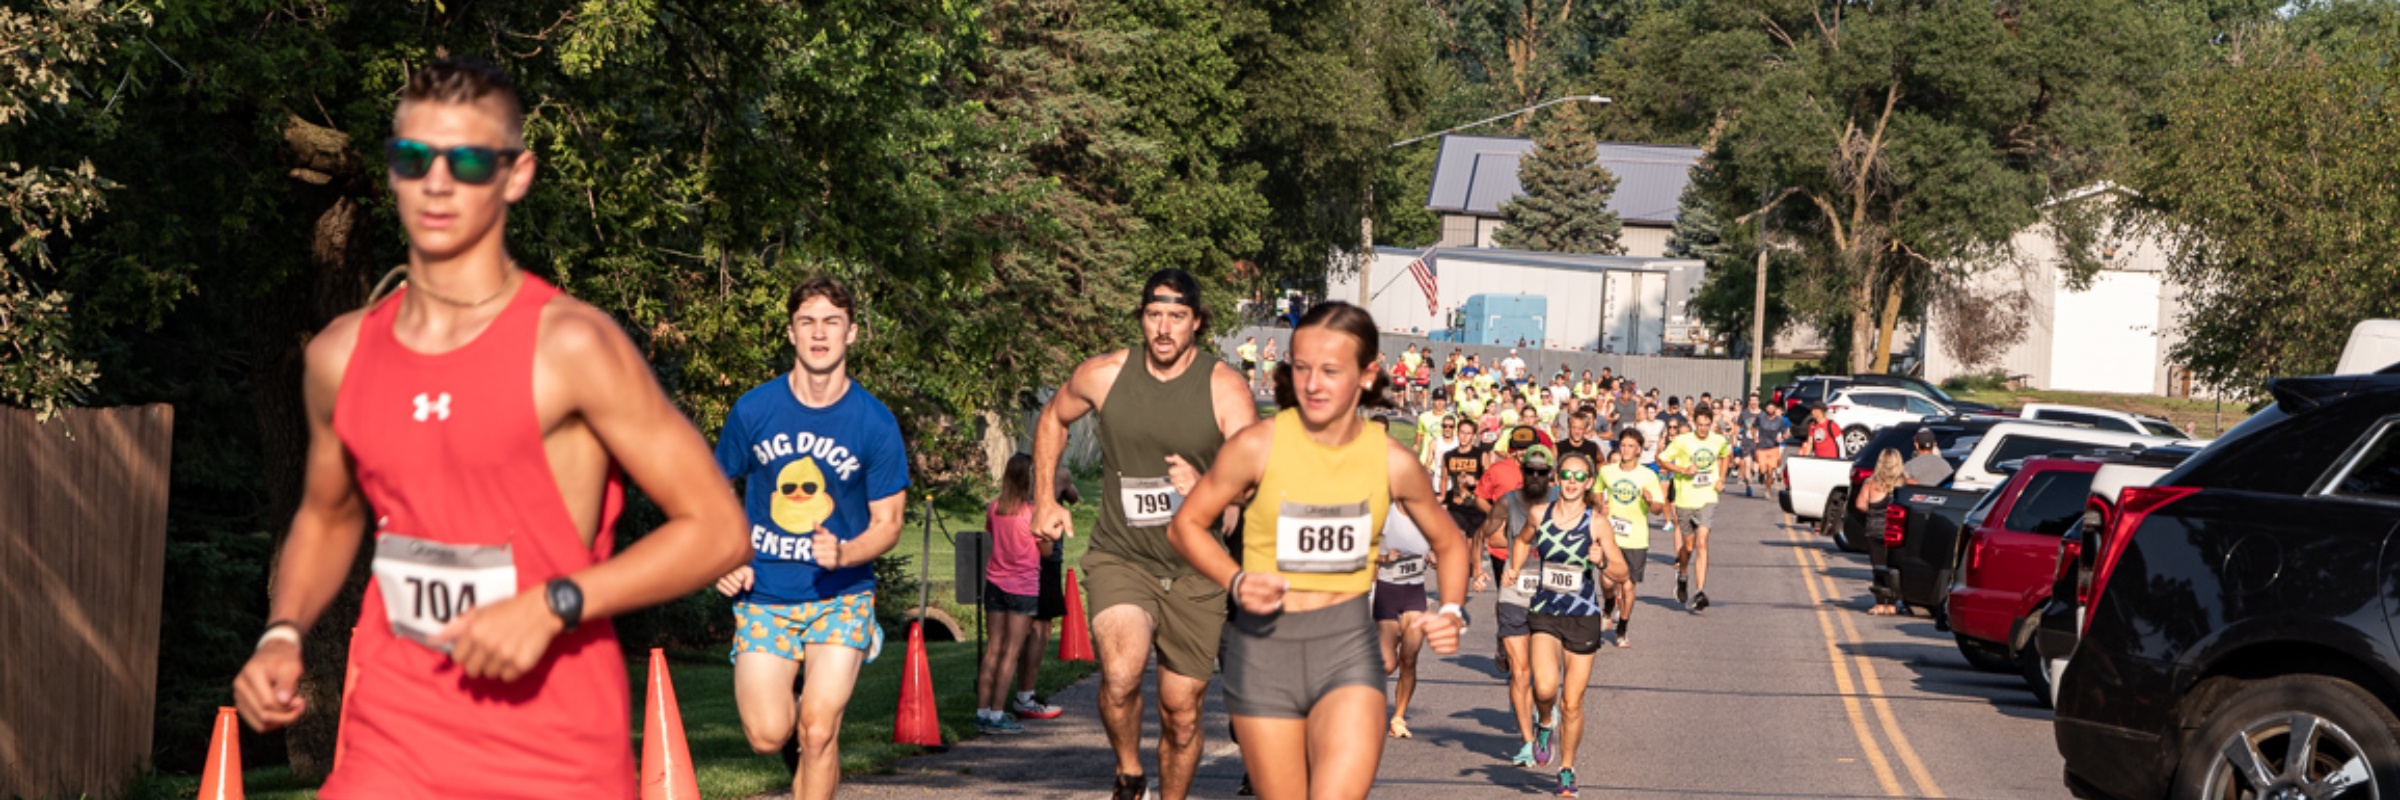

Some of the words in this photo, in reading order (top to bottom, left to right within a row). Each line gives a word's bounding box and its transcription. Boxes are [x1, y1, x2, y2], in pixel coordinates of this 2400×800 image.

[753, 433, 793, 465] BIG
[797, 432, 860, 480] DUCK
[1134, 492, 1171, 514] 799
[751, 524, 848, 561] ENER
[1298, 525, 1354, 553] 686
[1551, 571, 1573, 587] 706
